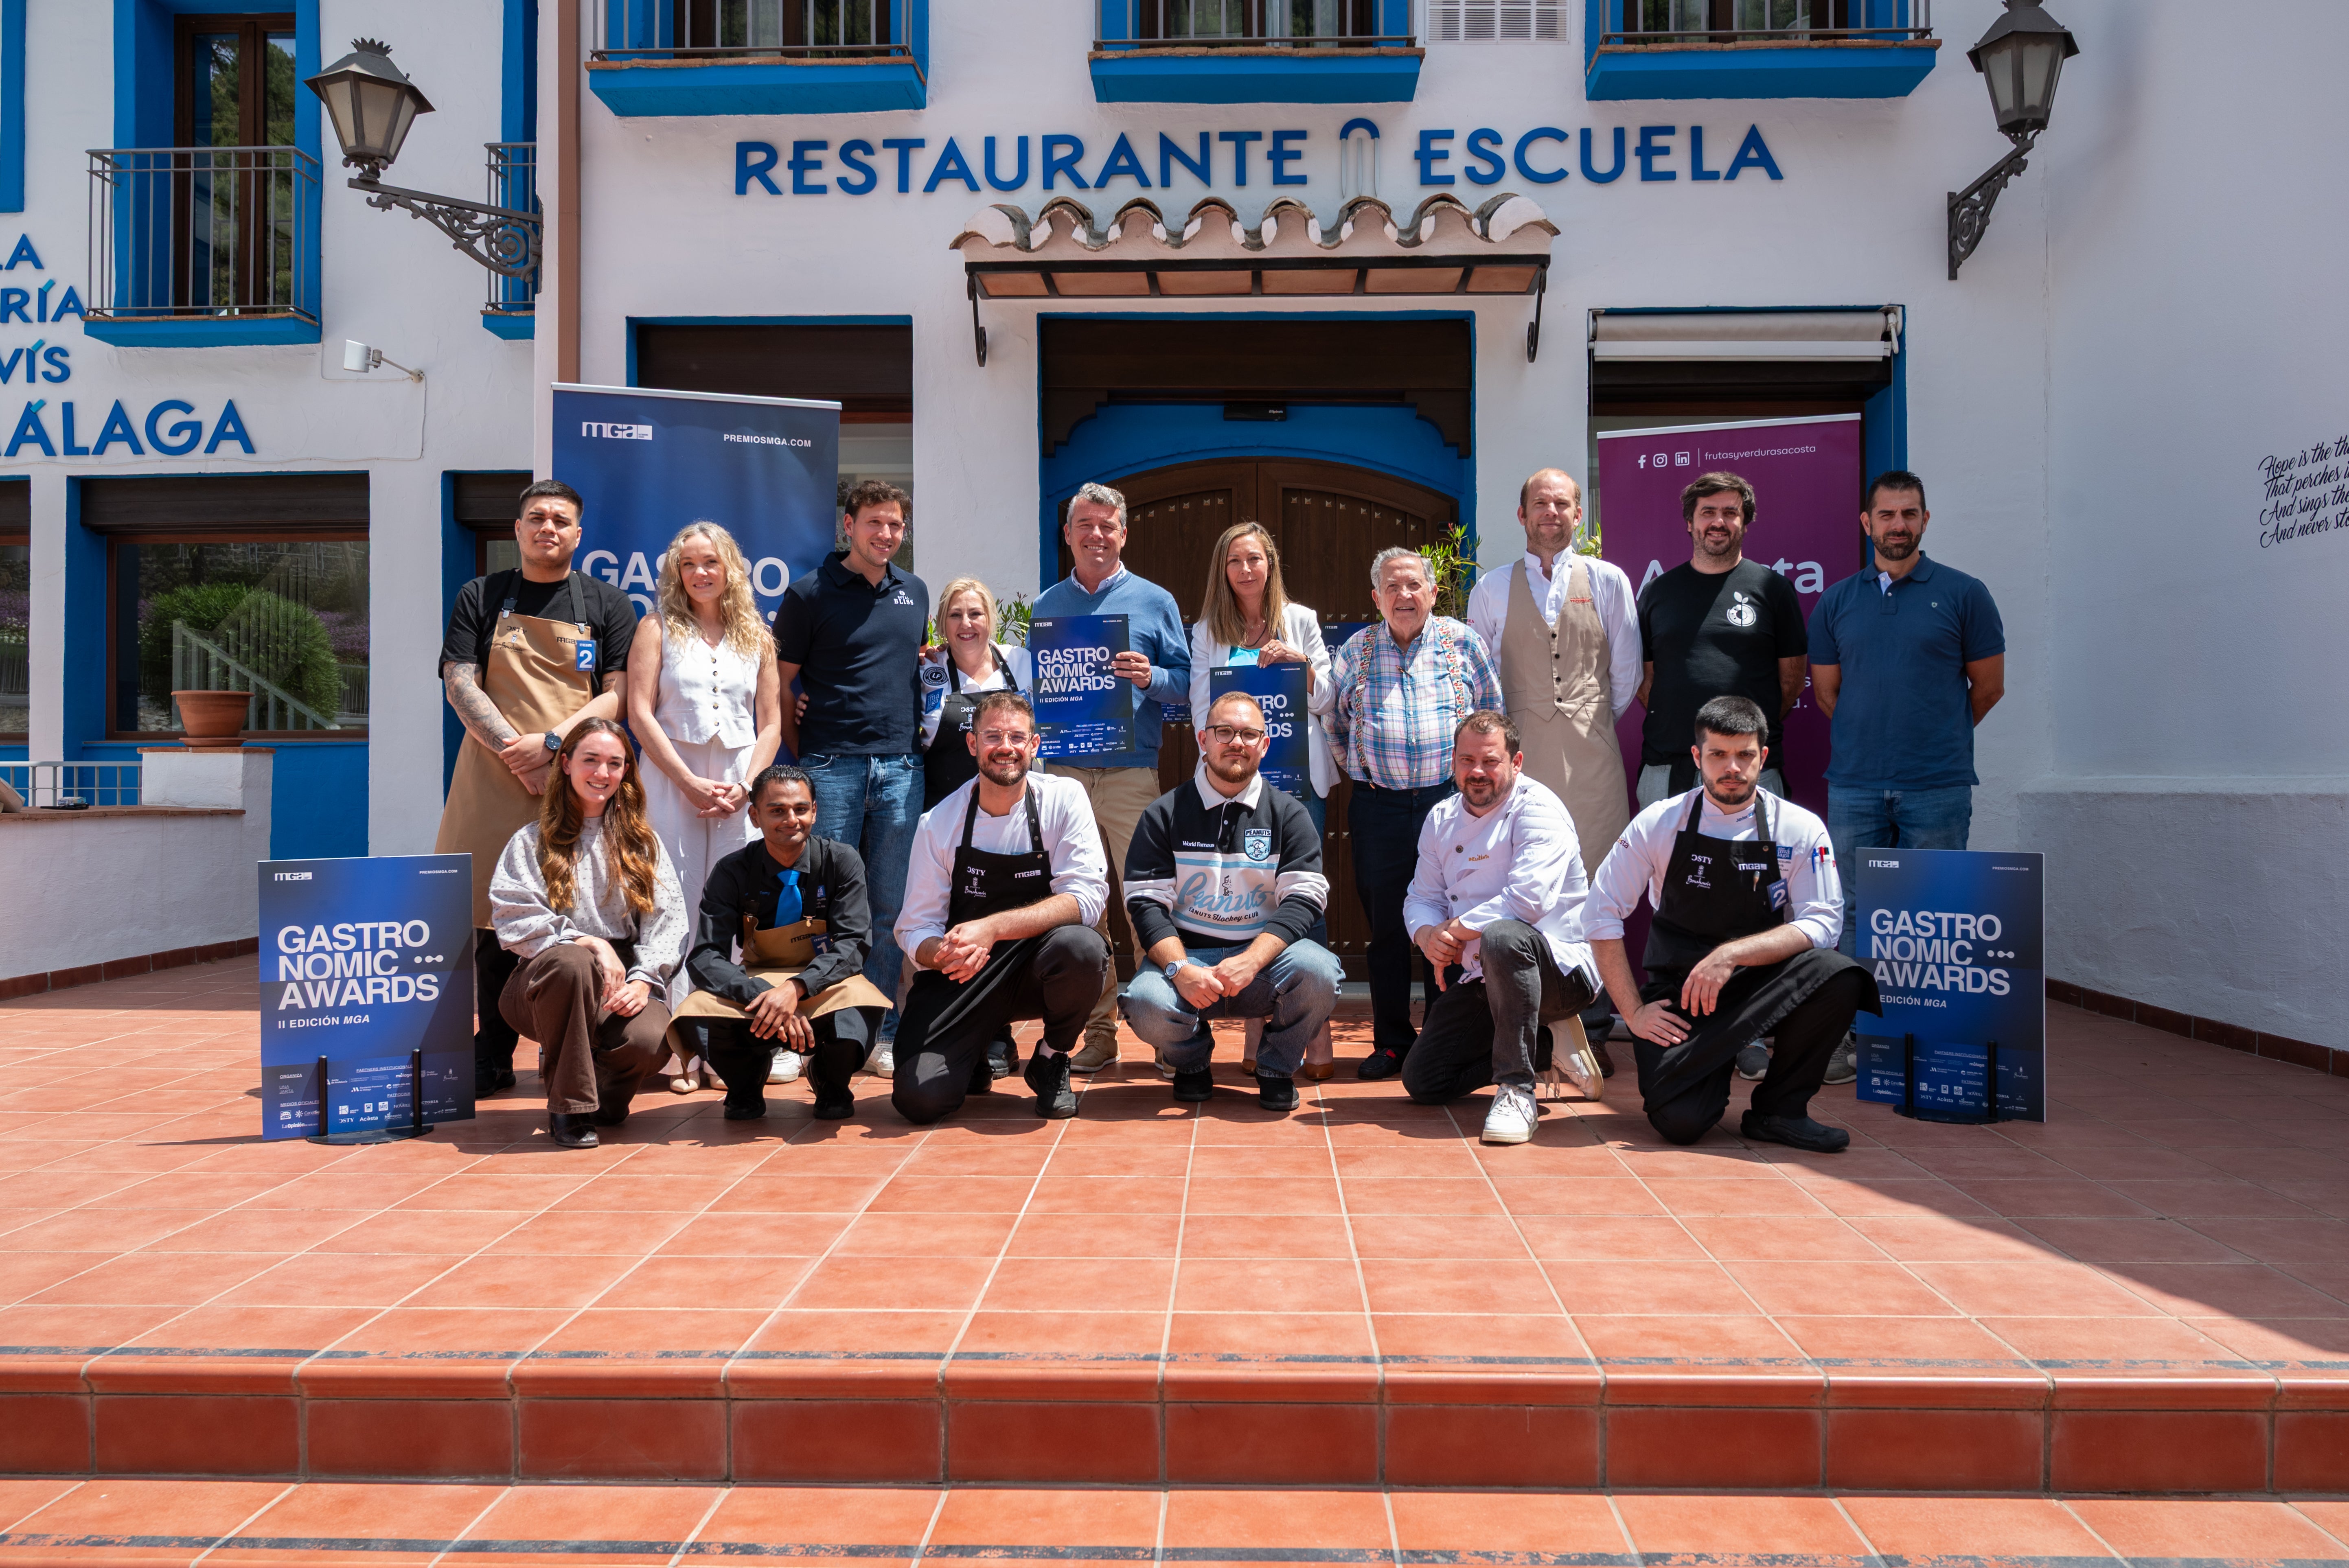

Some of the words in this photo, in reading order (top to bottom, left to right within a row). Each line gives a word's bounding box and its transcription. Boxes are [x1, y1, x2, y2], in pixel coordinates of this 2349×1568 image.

[735, 131, 1307, 195] RESTAURANTE
[1414, 125, 1783, 185] ESCUELA
[0, 233, 44, 270] A
[0, 399, 255, 457] ÁLAGA
[723, 434, 811, 447] PREMIOSMGA.COM
[1705, 445, 1816, 460] frutasyverdurasacosta
[2258, 456, 2296, 478] Hope
[2298, 450, 2310, 467] is
[2311, 442, 2333, 464] the
[2264, 475, 2296, 501] That
[2292, 464, 2342, 497] perches
[2260, 500, 2296, 525] And
[2297, 493, 2330, 521] sings
[2260, 523, 2297, 548] And
[2297, 516, 2332, 537] never
[581, 550, 790, 597] GAO
[579, 650, 592, 668] 2
[1037, 646, 1110, 665] GASTRO
[1039, 662, 1096, 679] NOMIC
[1039, 675, 1116, 694] AWARDS
[1177, 872, 1275, 913] Peanuts
[1773, 889, 1787, 908] 2
[1212, 913, 1243, 922] Hockey
[1244, 911, 1259, 920] CLUB
[1870, 909, 2002, 941] GASTRO
[277, 920, 430, 954] GASTRO
[817, 942, 828, 954] 1
[1871, 935, 1973, 965] NOMIC
[279, 949, 399, 981] NOMIC
[1874, 961, 2010, 996] AWARDS
[278, 974, 439, 1011] AWARDS
[1880, 994, 1920, 1005] EDICIÓN
[1924, 999, 1947, 1008] MGA
[278, 1020, 285, 1029] II
[289, 1015, 340, 1028] EDICIÓN
[343, 1014, 370, 1025] MGA
